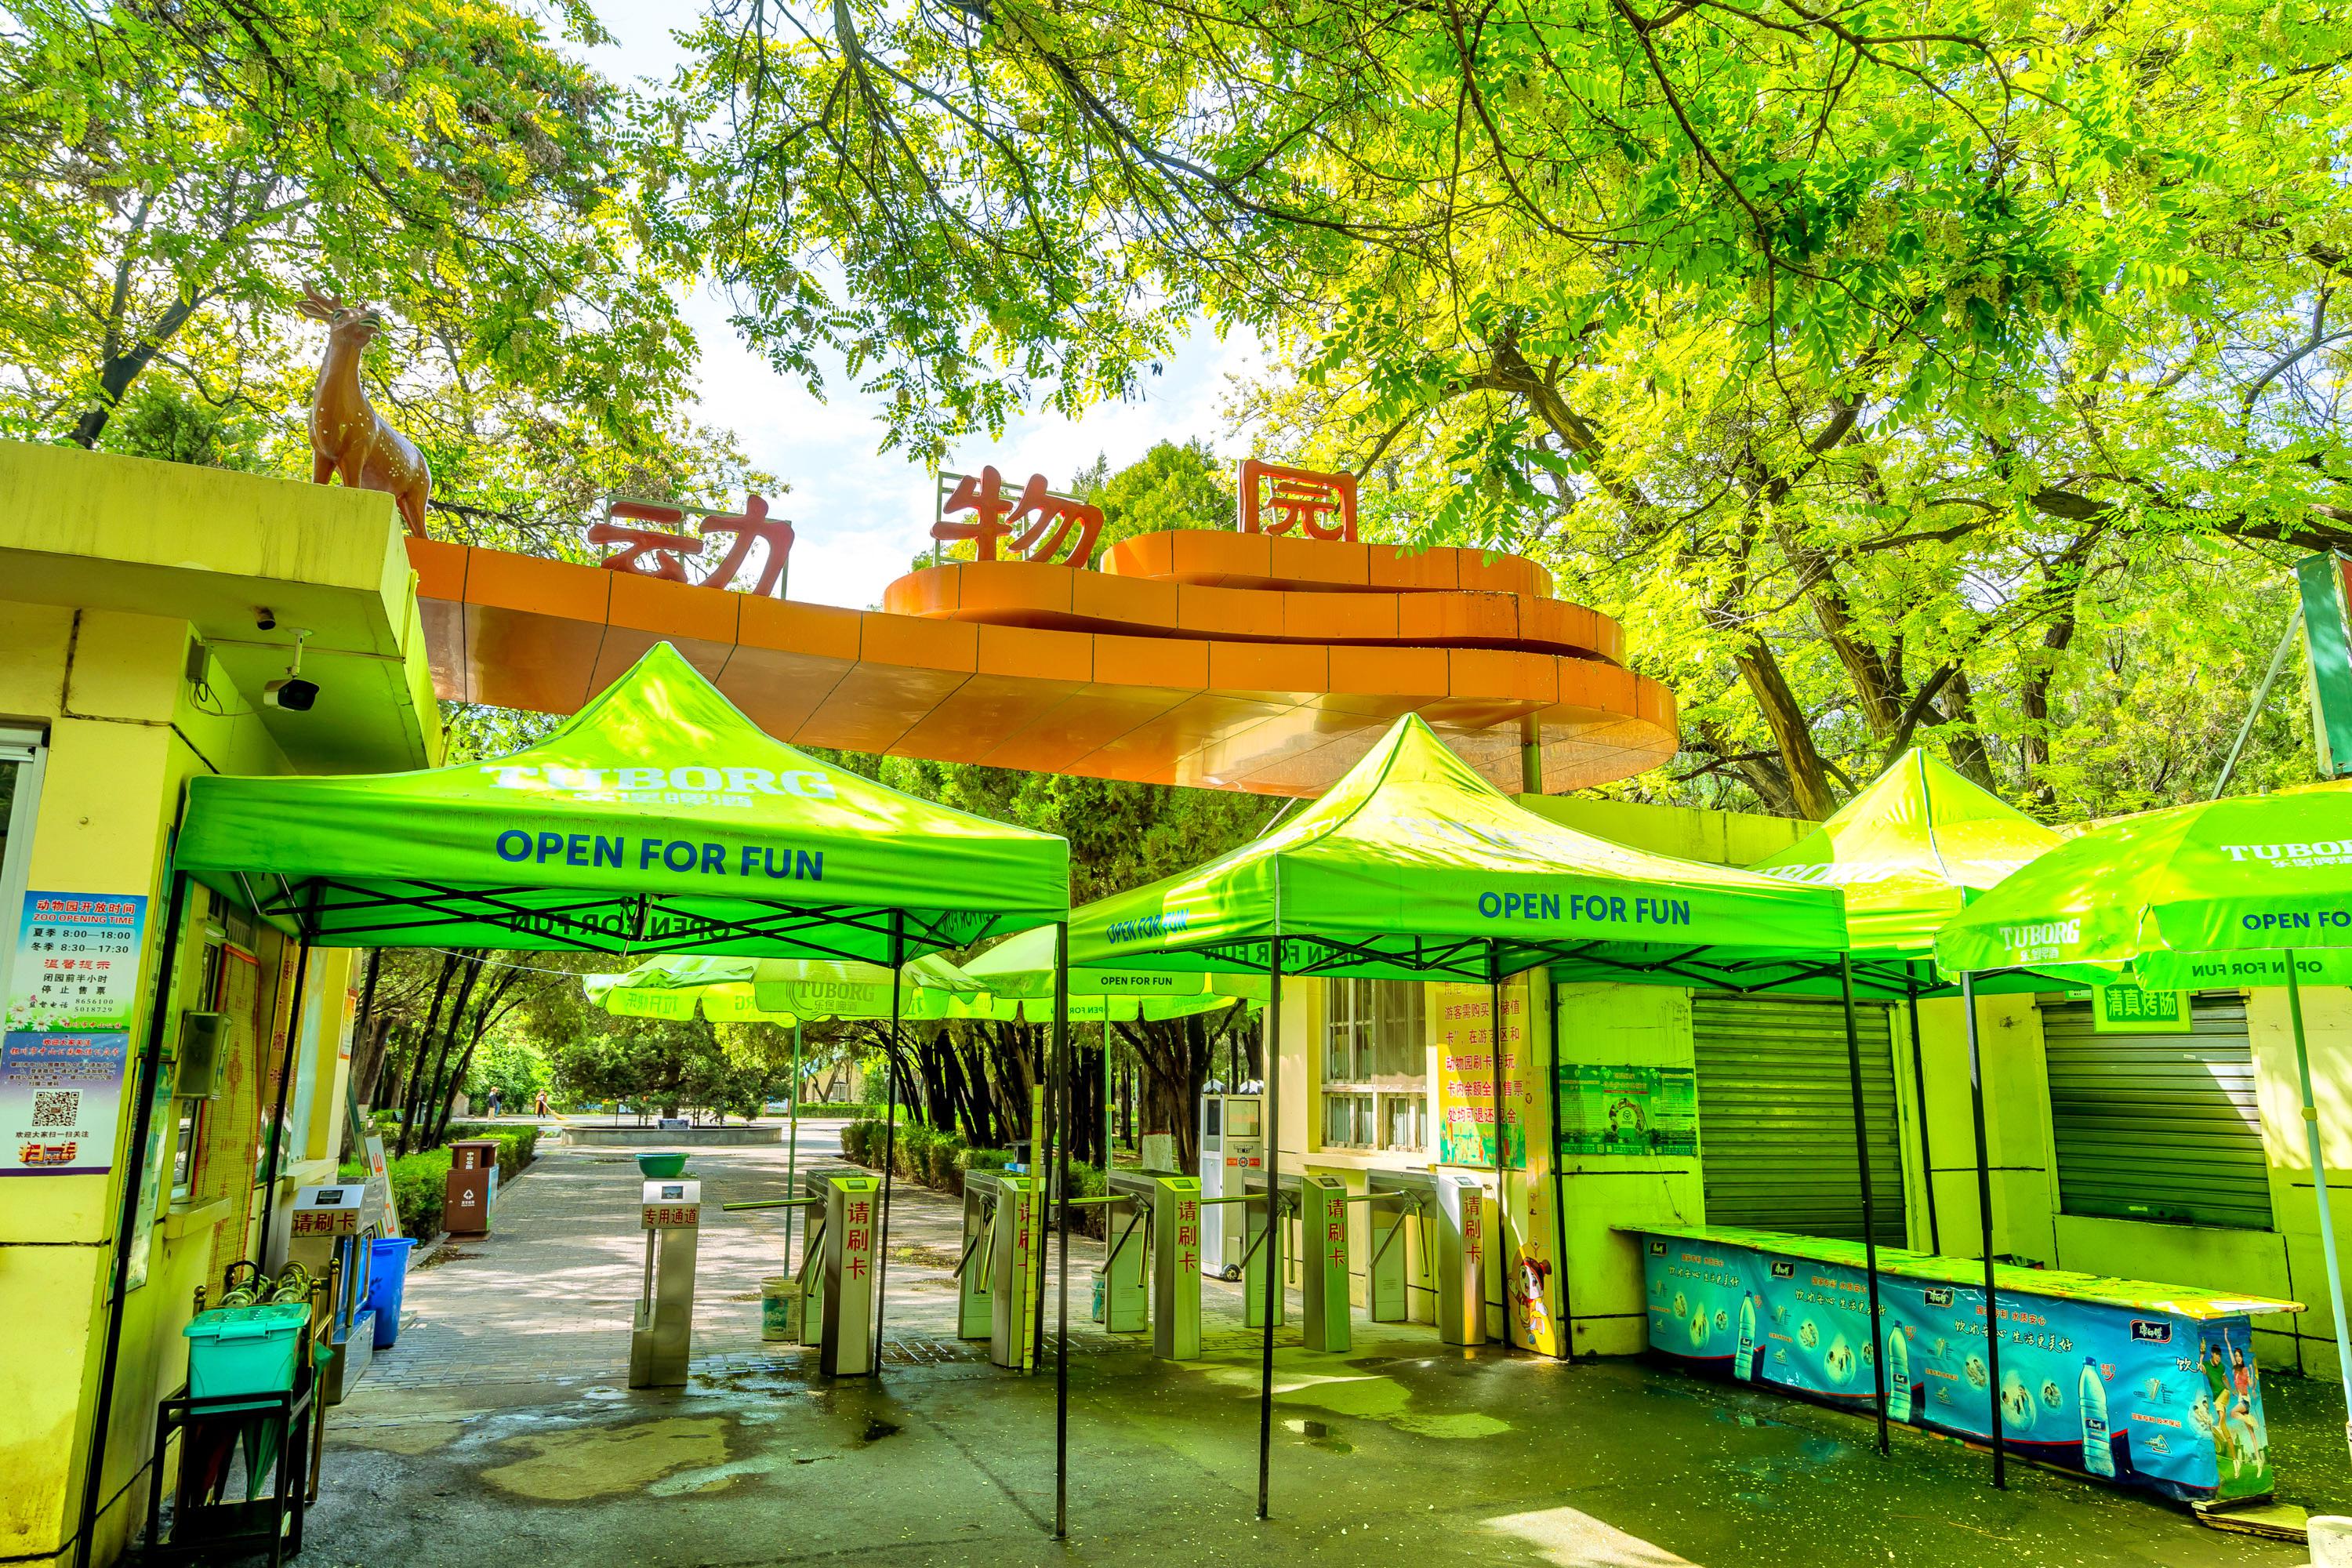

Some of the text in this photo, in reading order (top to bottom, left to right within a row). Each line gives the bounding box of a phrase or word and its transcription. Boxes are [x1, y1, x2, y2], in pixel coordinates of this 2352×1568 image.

[588, 459, 1357, 596] 动物园
[479, 766, 837, 800] TUBORG
[496, 829, 823, 881] OPEN FOR FUN
[37, 900, 136, 915] 动物园开放时间
[1479, 891, 1690, 925] OPEN FOR FUN
[59, 915, 107, 924] OPENING
[1106, 908, 1189, 944] OPEN FOR FUN
[2242, 911, 2352, 930] OPEN FO
[33, 927, 56, 938] 夏季
[2000, 918, 2081, 951] TUBORG
[31, 942, 54, 951] 冬季
[44, 959, 111, 970] 温馨提示
[43, 973, 107, 983] 闭园前半小时
[1101, 977, 1172, 985] OPEN FOR FUN
[799, 982, 875, 1002] TUBORG
[814, 1000, 858, 1011] 乐堡啤酒
[1445, 999, 1520, 1020] 游客需购买储值
[2107, 989, 2176, 1017] 清真烤肠
[1447, 1080, 1523, 1097] 卡内余额全售票
[294, 1212, 355, 1232] 请刷卡
[644, 1207, 698, 1225] 专用通道
[846, 1201, 871, 1280] 请刷卡
[1178, 1200, 1198, 1274] 请刷卡
[1327, 1198, 1347, 1269] 请刷卡
[1464, 1196, 1483, 1265] 请刷卡
[1976, 1305, 2045, 1326] 国专利 水质安心
[2013, 1330, 2074, 1353] 生活更美好
